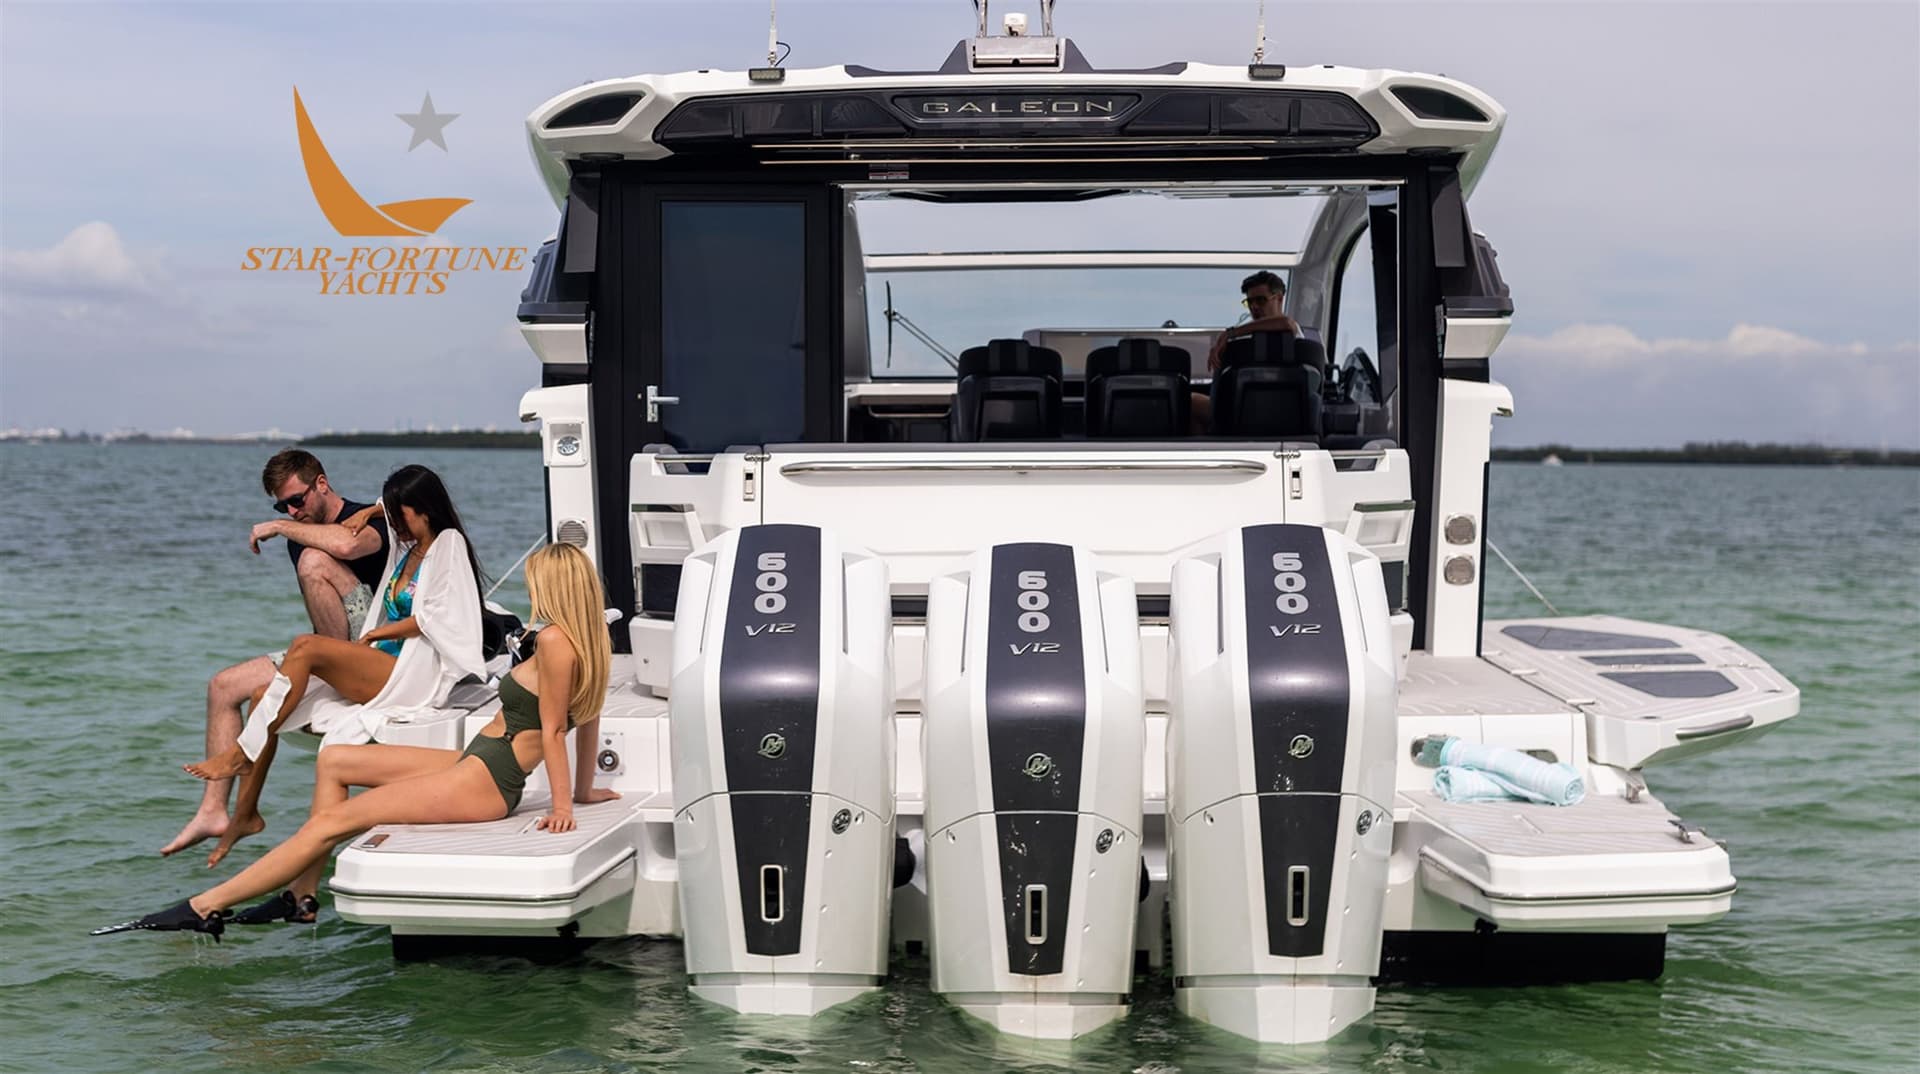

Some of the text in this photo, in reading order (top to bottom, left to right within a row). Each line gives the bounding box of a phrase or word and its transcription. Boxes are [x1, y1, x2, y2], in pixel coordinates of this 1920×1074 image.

[922, 101, 1113, 113] GALEON
[754, 552, 788, 614] 600
[1272, 552, 1309, 615] 600
[1017, 570, 1051, 633] 600
[744, 622, 798, 637] V12
[1268, 623, 1322, 638] V12
[1008, 641, 1062, 655] V12
